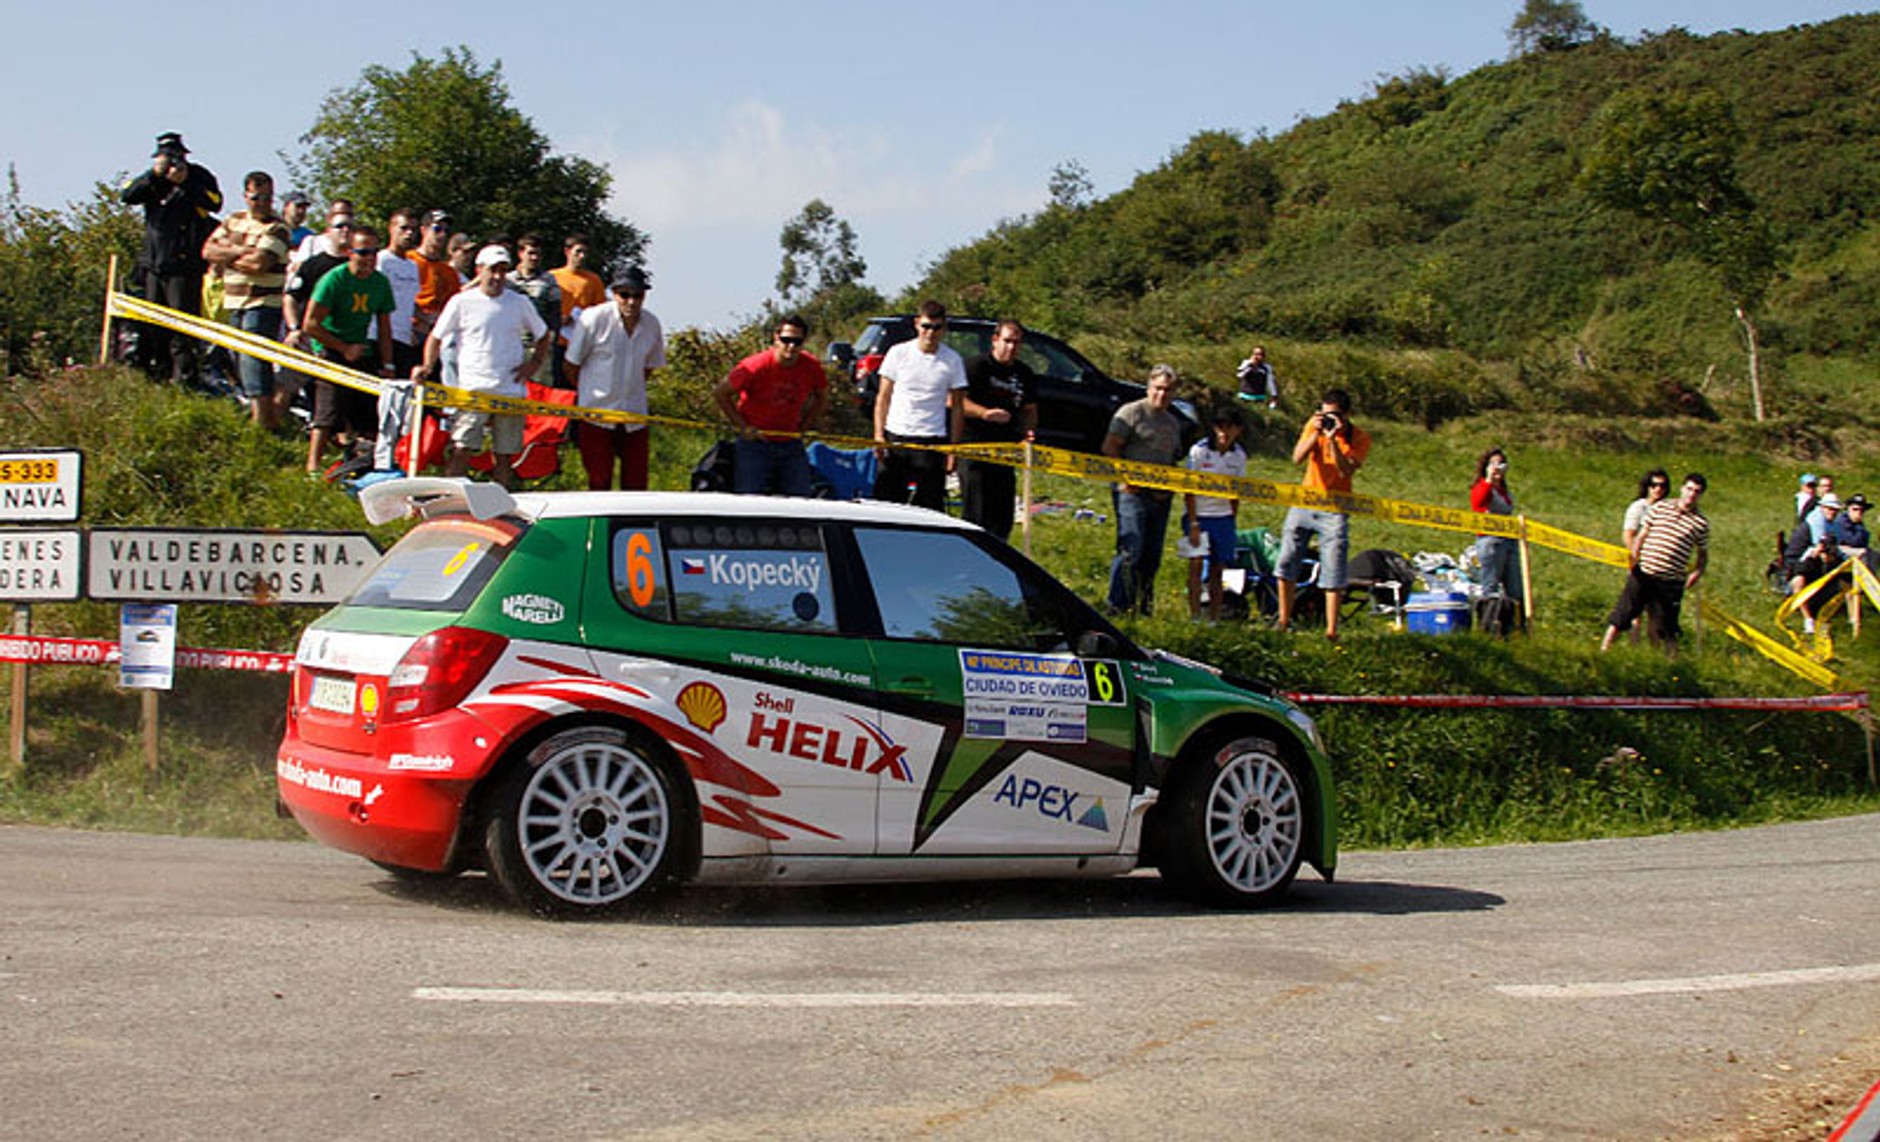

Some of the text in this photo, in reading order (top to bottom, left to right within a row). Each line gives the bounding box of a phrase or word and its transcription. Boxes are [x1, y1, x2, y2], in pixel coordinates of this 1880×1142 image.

[4, 488, 67, 508] NAVA
[442, 541, 480, 577] 6
[627, 532, 656, 608] 6
[709, 554, 821, 594] Kopecký
[730, 652, 871, 686] www.skoda-auto.com
[966, 678, 1087, 698] CIUDAD DE OVIEDO
[1094, 661, 1114, 702] 6
[754, 691, 795, 713] Shell
[747, 711, 909, 781] HELIX
[994, 773, 1079, 822] APEX
